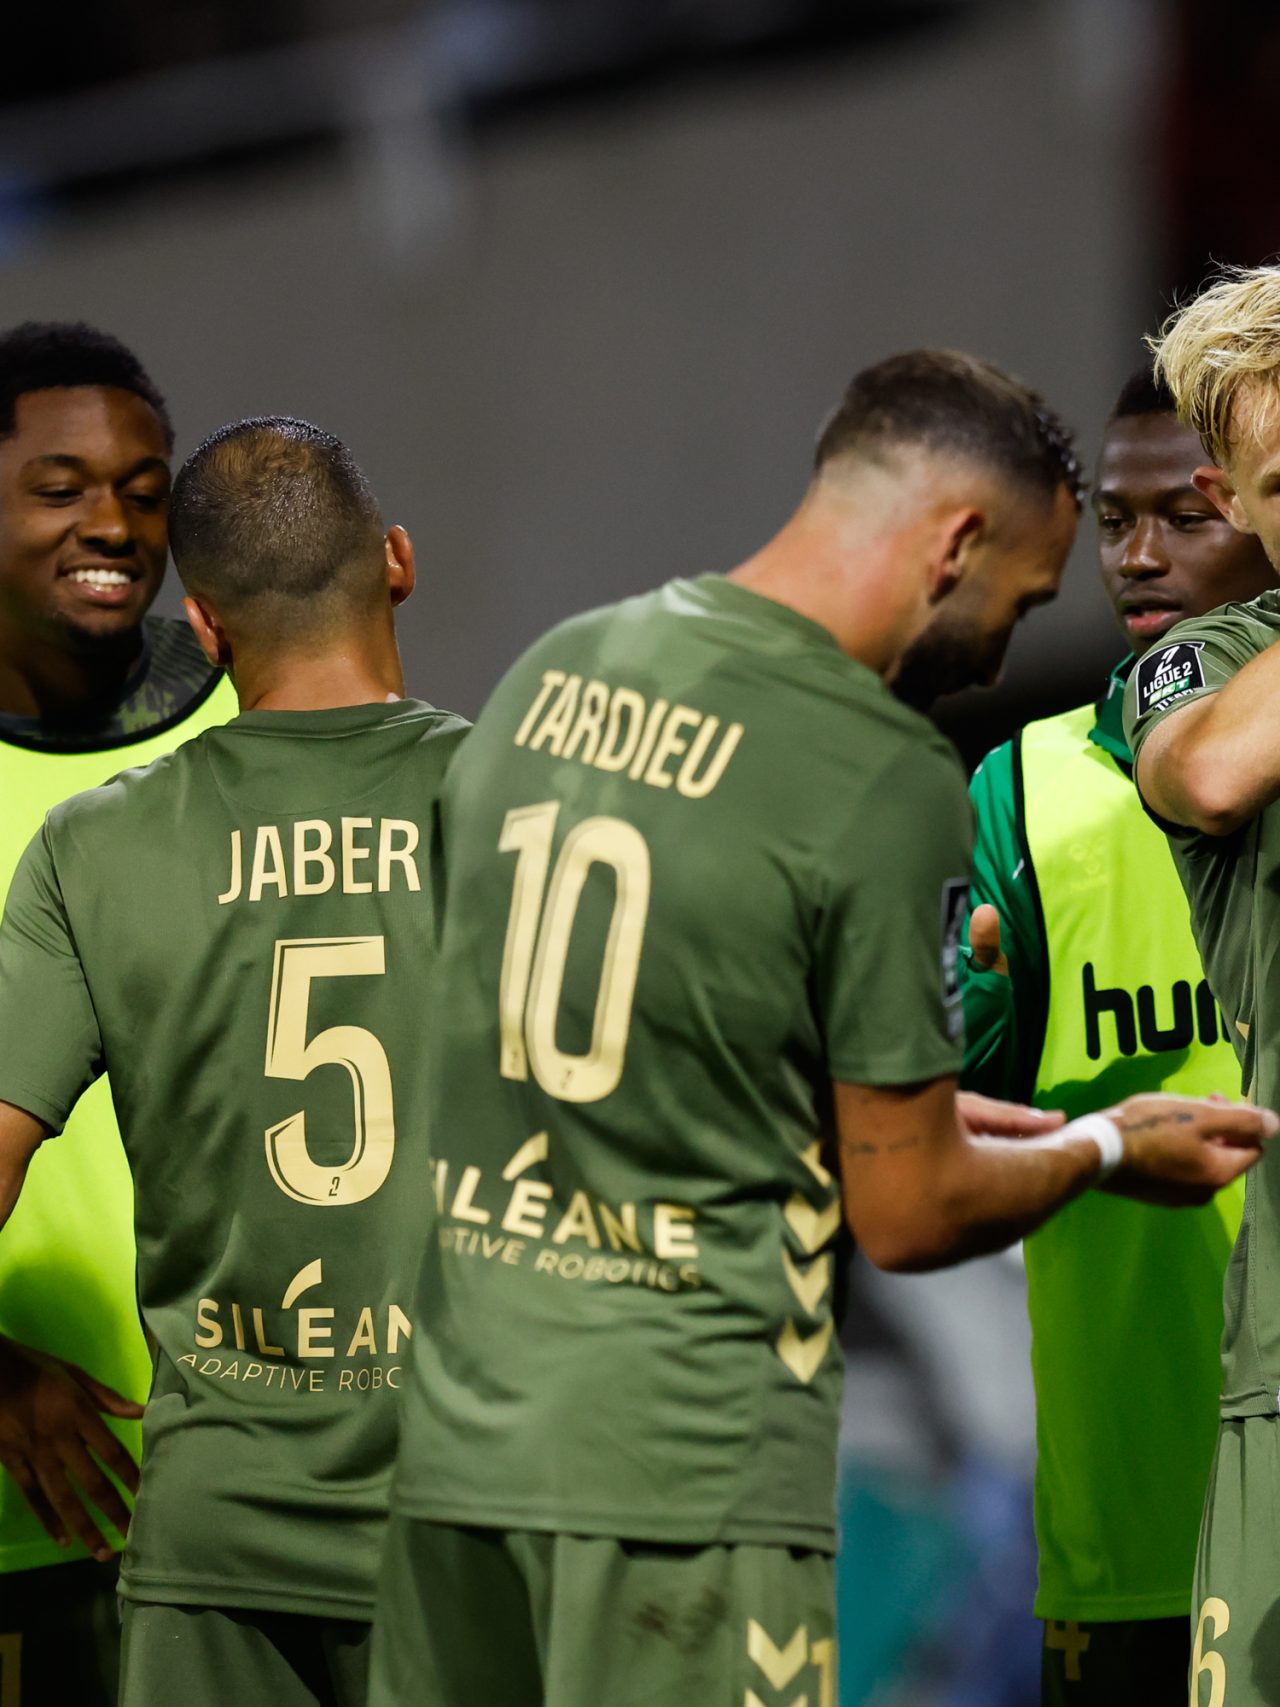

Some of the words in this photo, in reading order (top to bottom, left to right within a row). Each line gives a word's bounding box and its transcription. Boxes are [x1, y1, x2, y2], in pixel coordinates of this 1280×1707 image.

[1143, 666, 1182, 698] LIGUE
[1182, 661, 1193, 677] 2
[514, 670, 744, 799] TARDIEU
[218, 816, 422, 905] JABER
[498, 800, 652, 1104] 10
[264, 935, 396, 1207] 5
[328, 1176, 340, 1197] 2
[429, 1131, 699, 1260] ILÉANE
[439, 1227, 527, 1265] TIVE
[176, 1353, 325, 1392] ADAPTIVE
[1191, 1597, 1231, 1707] 6
